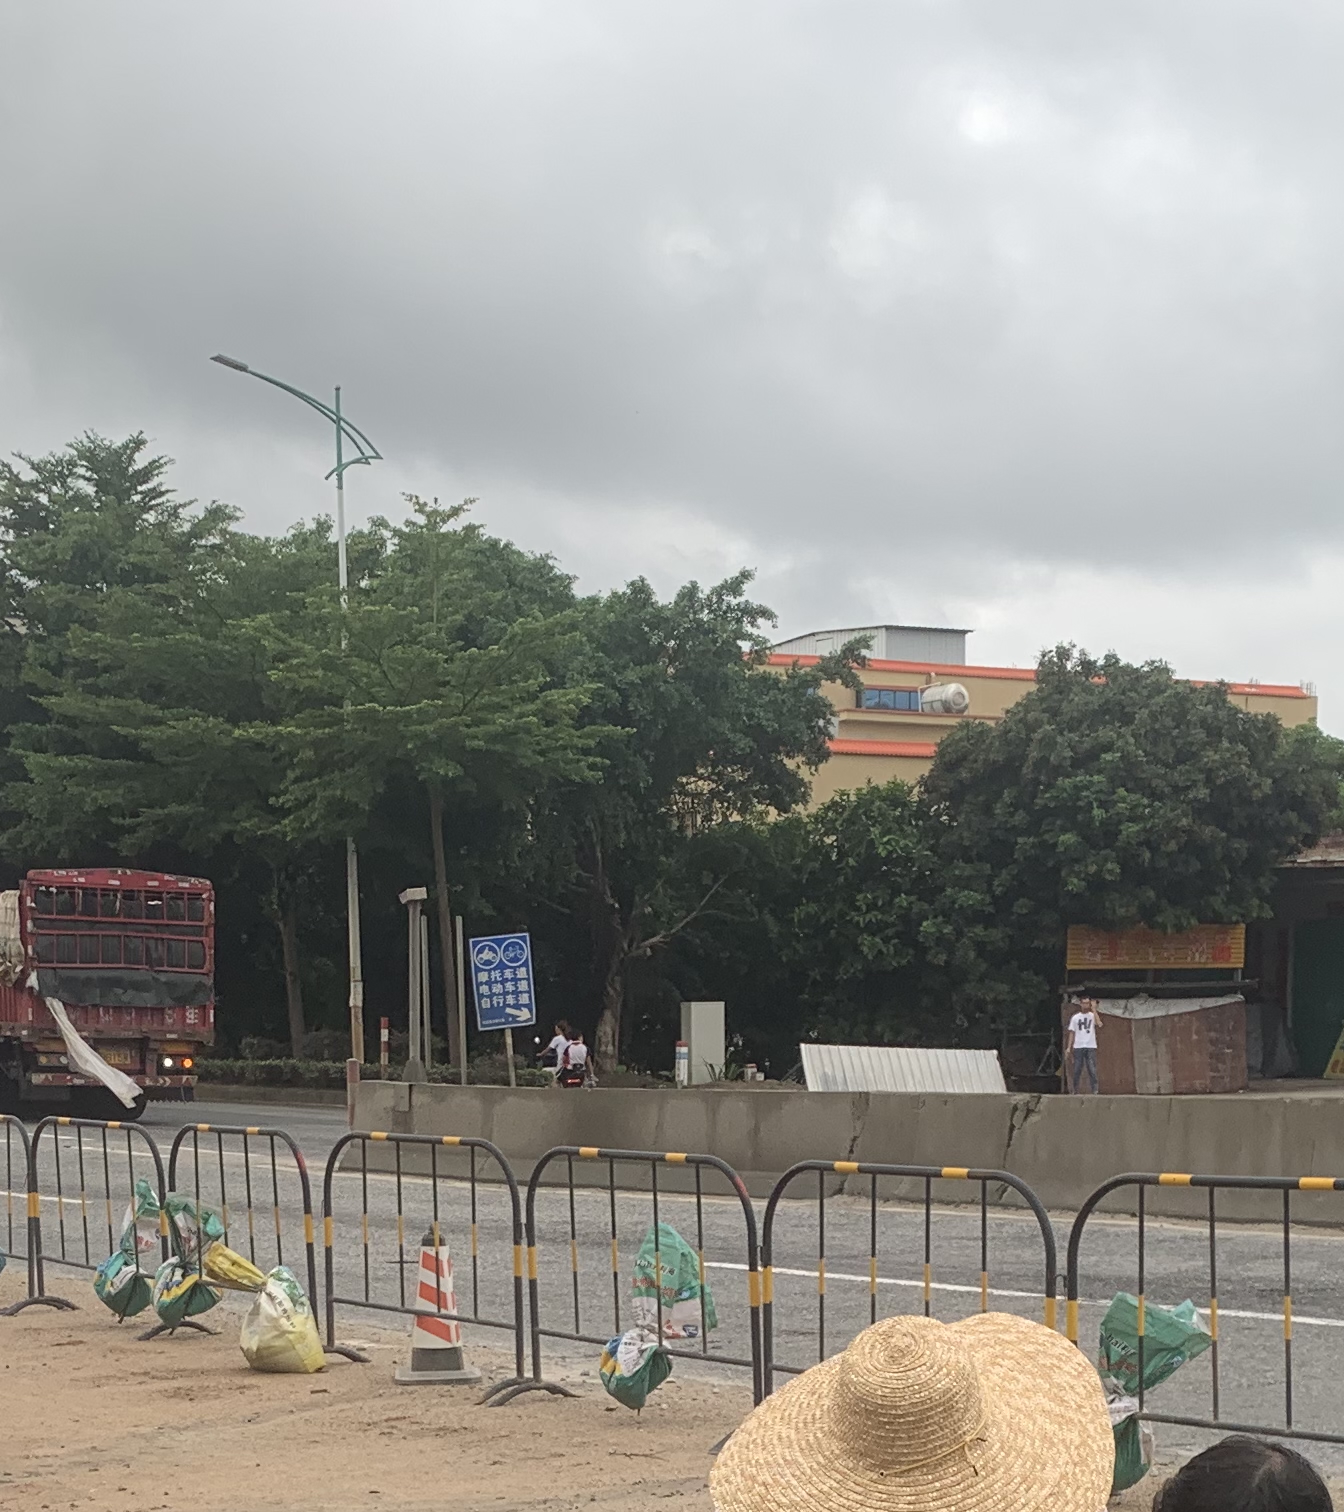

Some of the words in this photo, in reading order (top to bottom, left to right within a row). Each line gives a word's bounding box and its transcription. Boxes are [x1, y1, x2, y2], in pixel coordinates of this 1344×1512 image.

[477, 967, 528, 983] 摩托车道
[479, 980, 529, 995] 电动车道
[481, 993, 531, 1008] 自行车道
